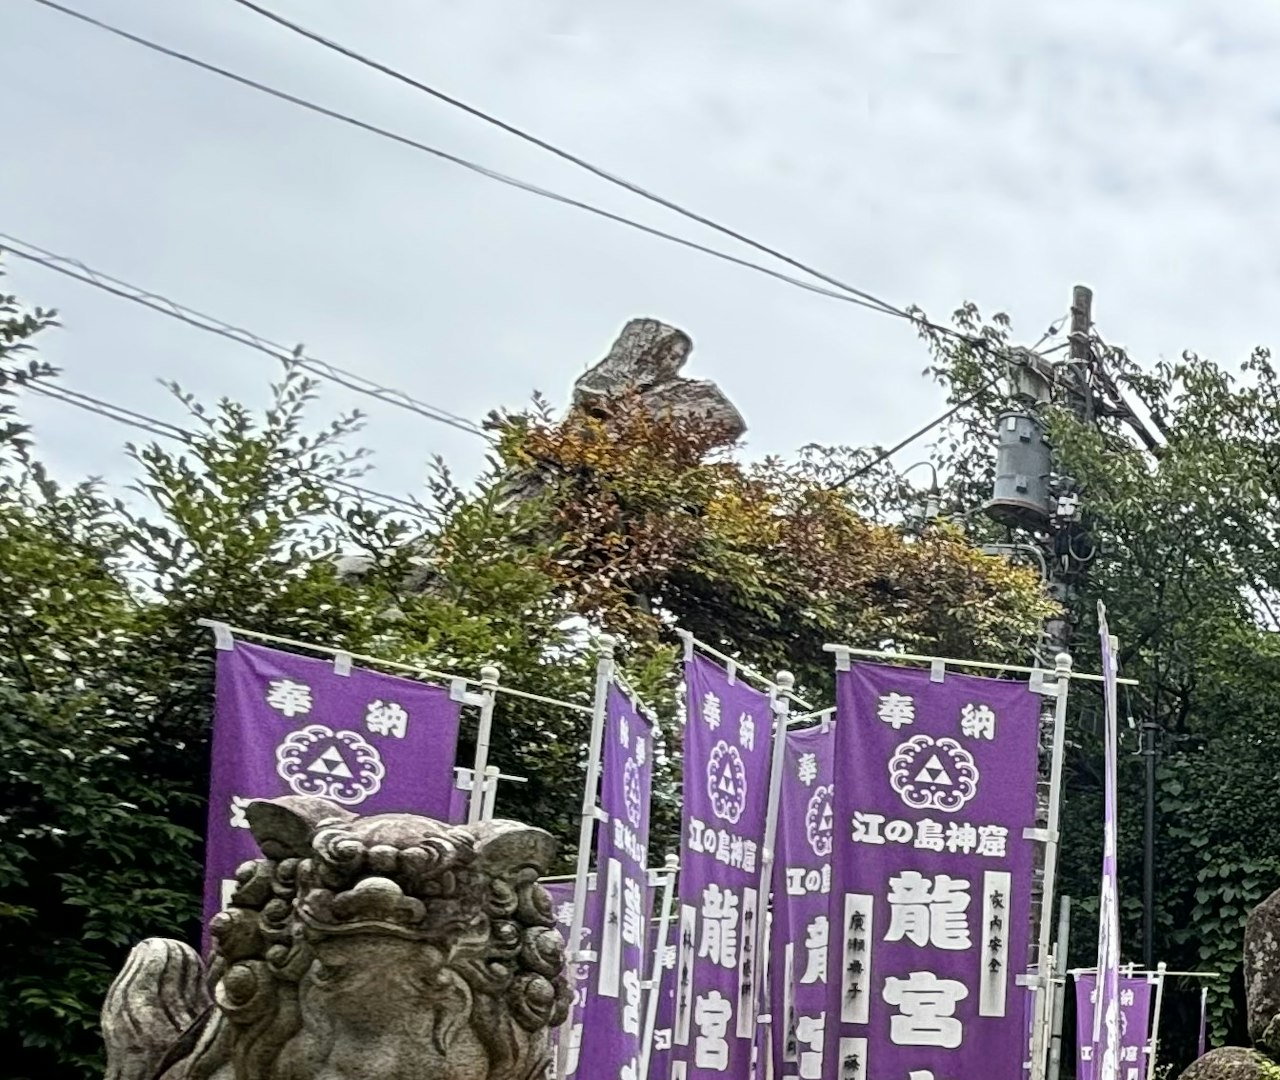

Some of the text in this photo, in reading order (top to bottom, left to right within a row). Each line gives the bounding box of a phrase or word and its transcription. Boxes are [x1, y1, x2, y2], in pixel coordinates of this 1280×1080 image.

[266, 679, 409, 739] 奉納
[877, 692, 996, 740] 奉納
[852, 811, 1009, 857] 江の島神窟
[988, 891, 1006, 974] 家内安全
